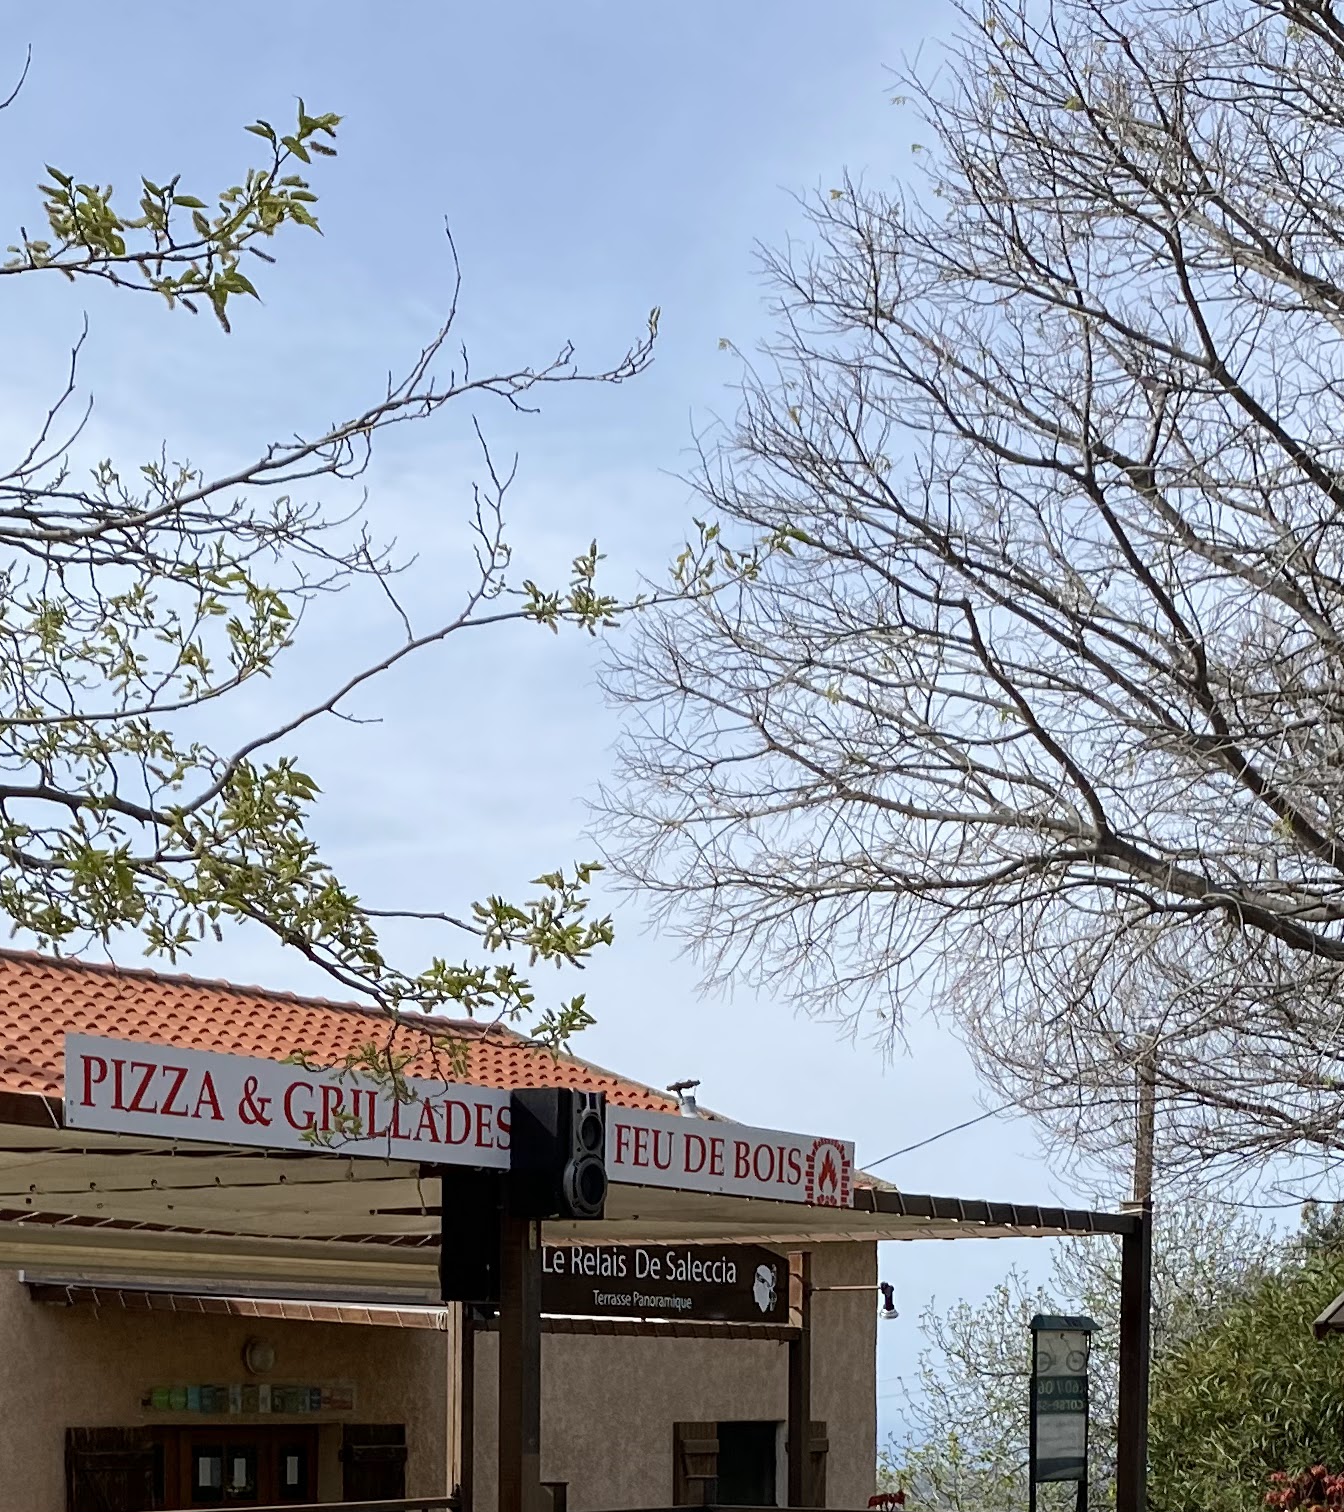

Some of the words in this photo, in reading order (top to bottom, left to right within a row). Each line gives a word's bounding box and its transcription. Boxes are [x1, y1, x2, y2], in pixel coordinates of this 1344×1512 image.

[80, 1054, 225, 1121] PIZZA
[238, 1075, 273, 1127] &
[284, 1081, 511, 1150] GRILLADES
[614, 1123, 674, 1170] FEU
[683, 1133, 725, 1176] DE
[733, 1140, 802, 1185] BOIS
[542, 1246, 565, 1273] Le
[571, 1247, 627, 1278] Relais
[636, 1249, 661, 1279] De
[666, 1251, 736, 1283] Saleccia
[593, 1290, 631, 1307] Terrasse
[633, 1291, 692, 1312] Panoramique
